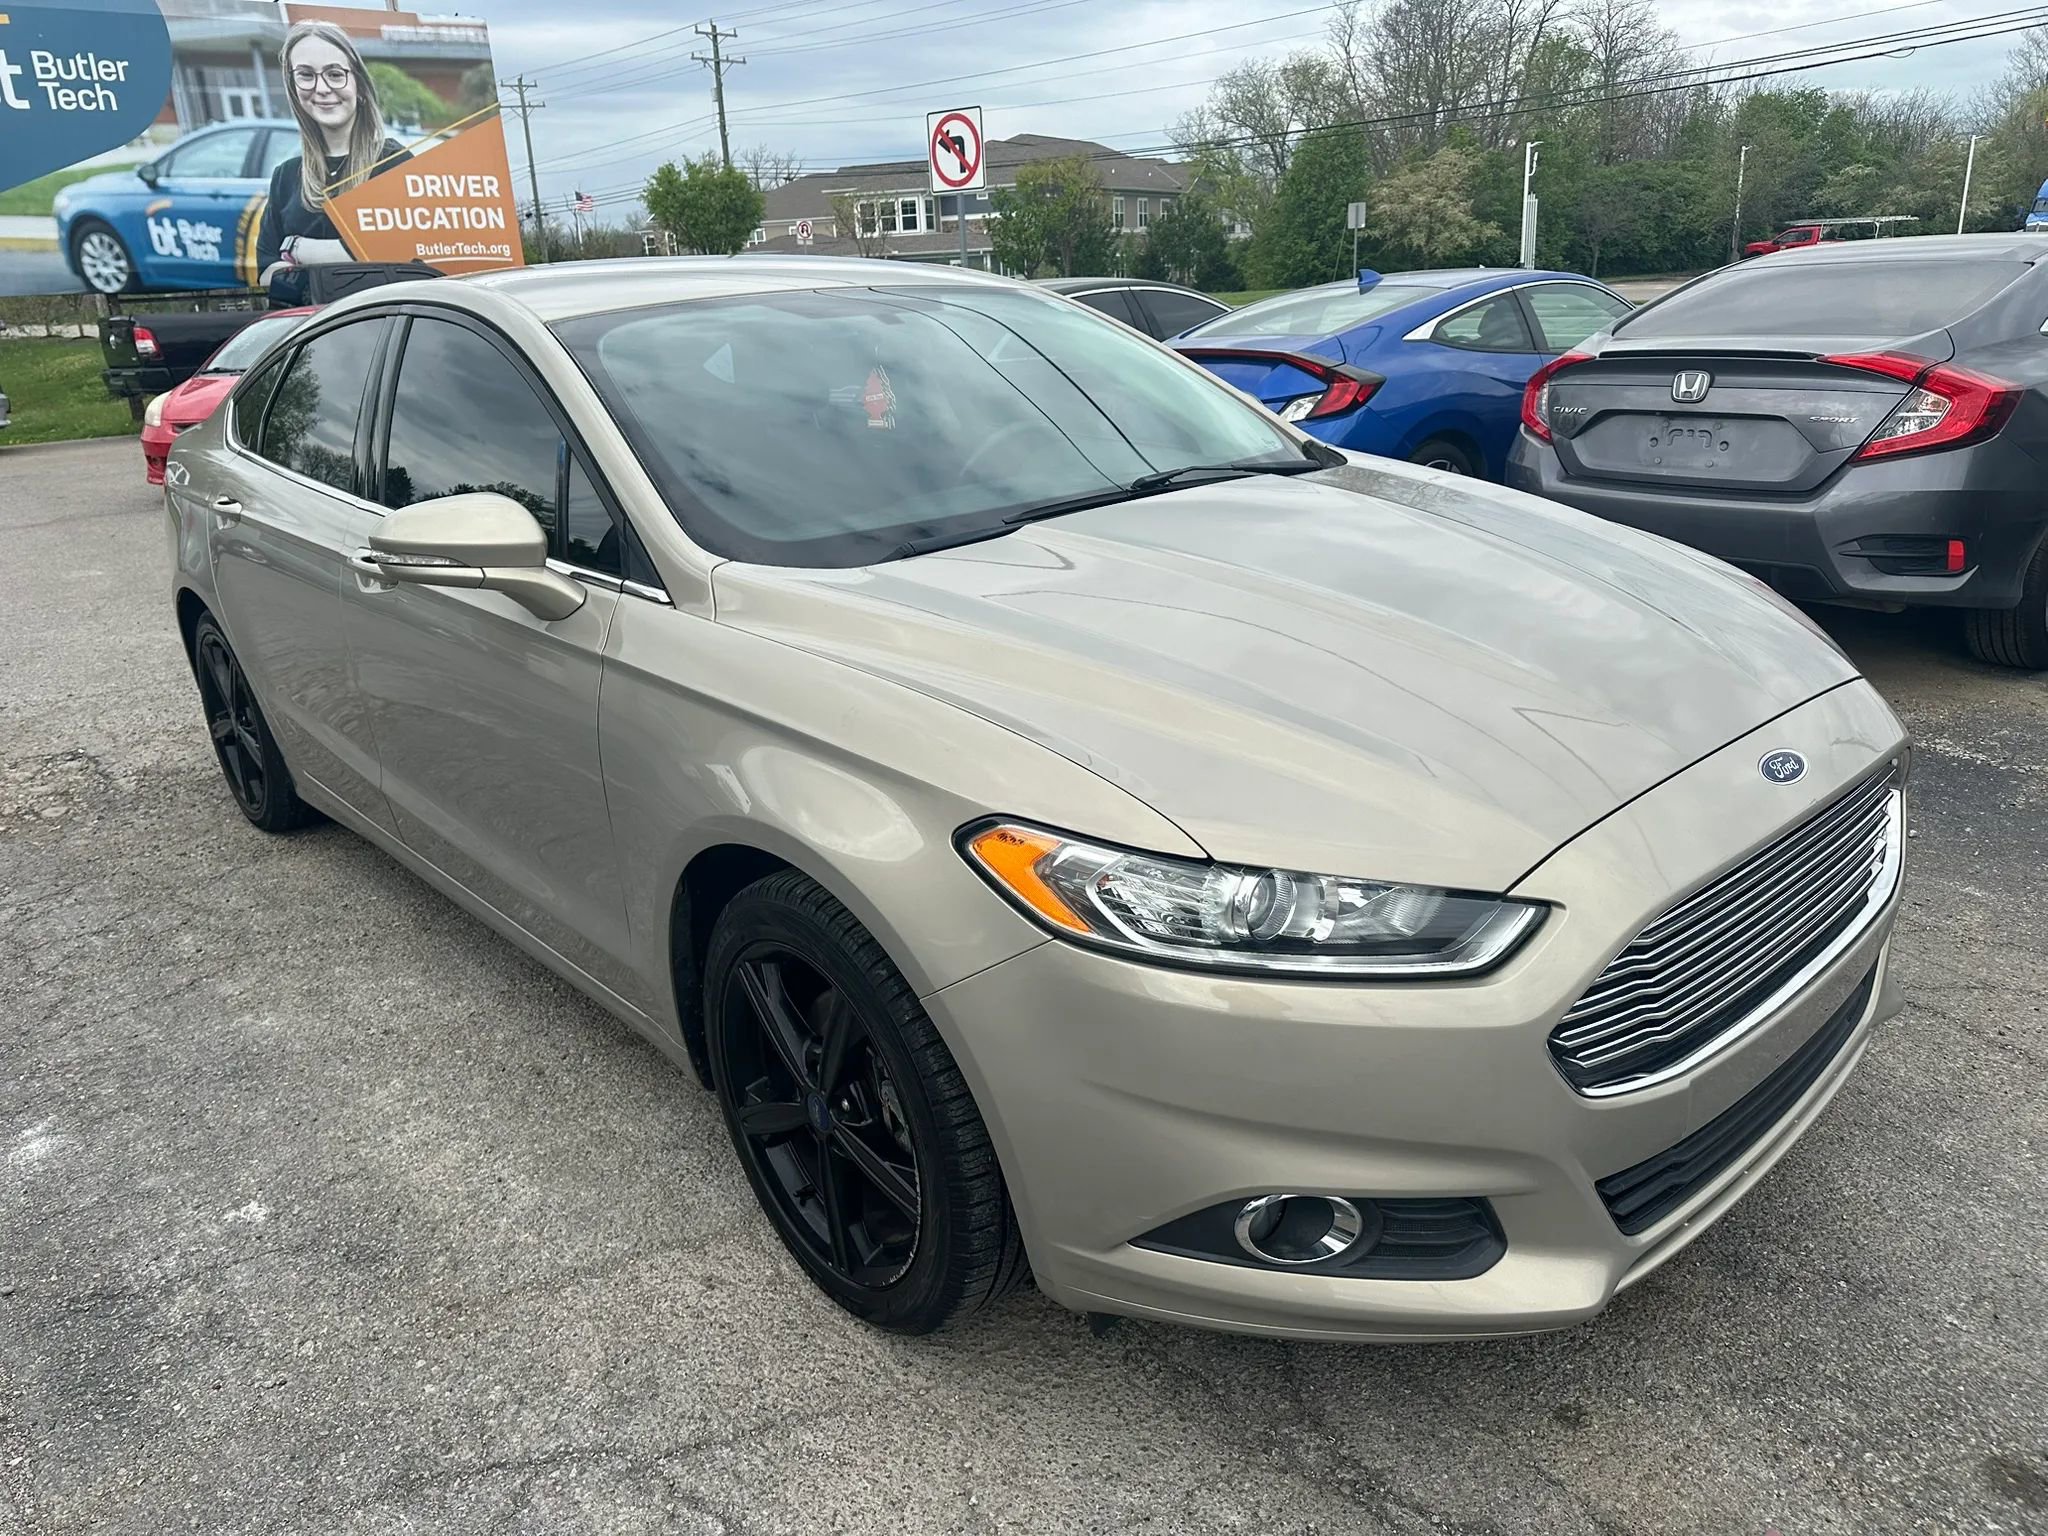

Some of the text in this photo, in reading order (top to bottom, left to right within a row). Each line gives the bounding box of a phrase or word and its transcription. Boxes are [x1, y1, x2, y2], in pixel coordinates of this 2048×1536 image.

[30, 50, 128, 81] Butler
[0, 49, 31, 110] t
[38, 81, 118, 111] Tech
[405, 174, 500, 198] DRIVER
[356, 207, 506, 232] EDUCATION
[415, 242, 512, 257] ButlerTech.org
[1553, 406, 1588, 415] CIVIC
[1768, 756, 1800, 779] Ford
